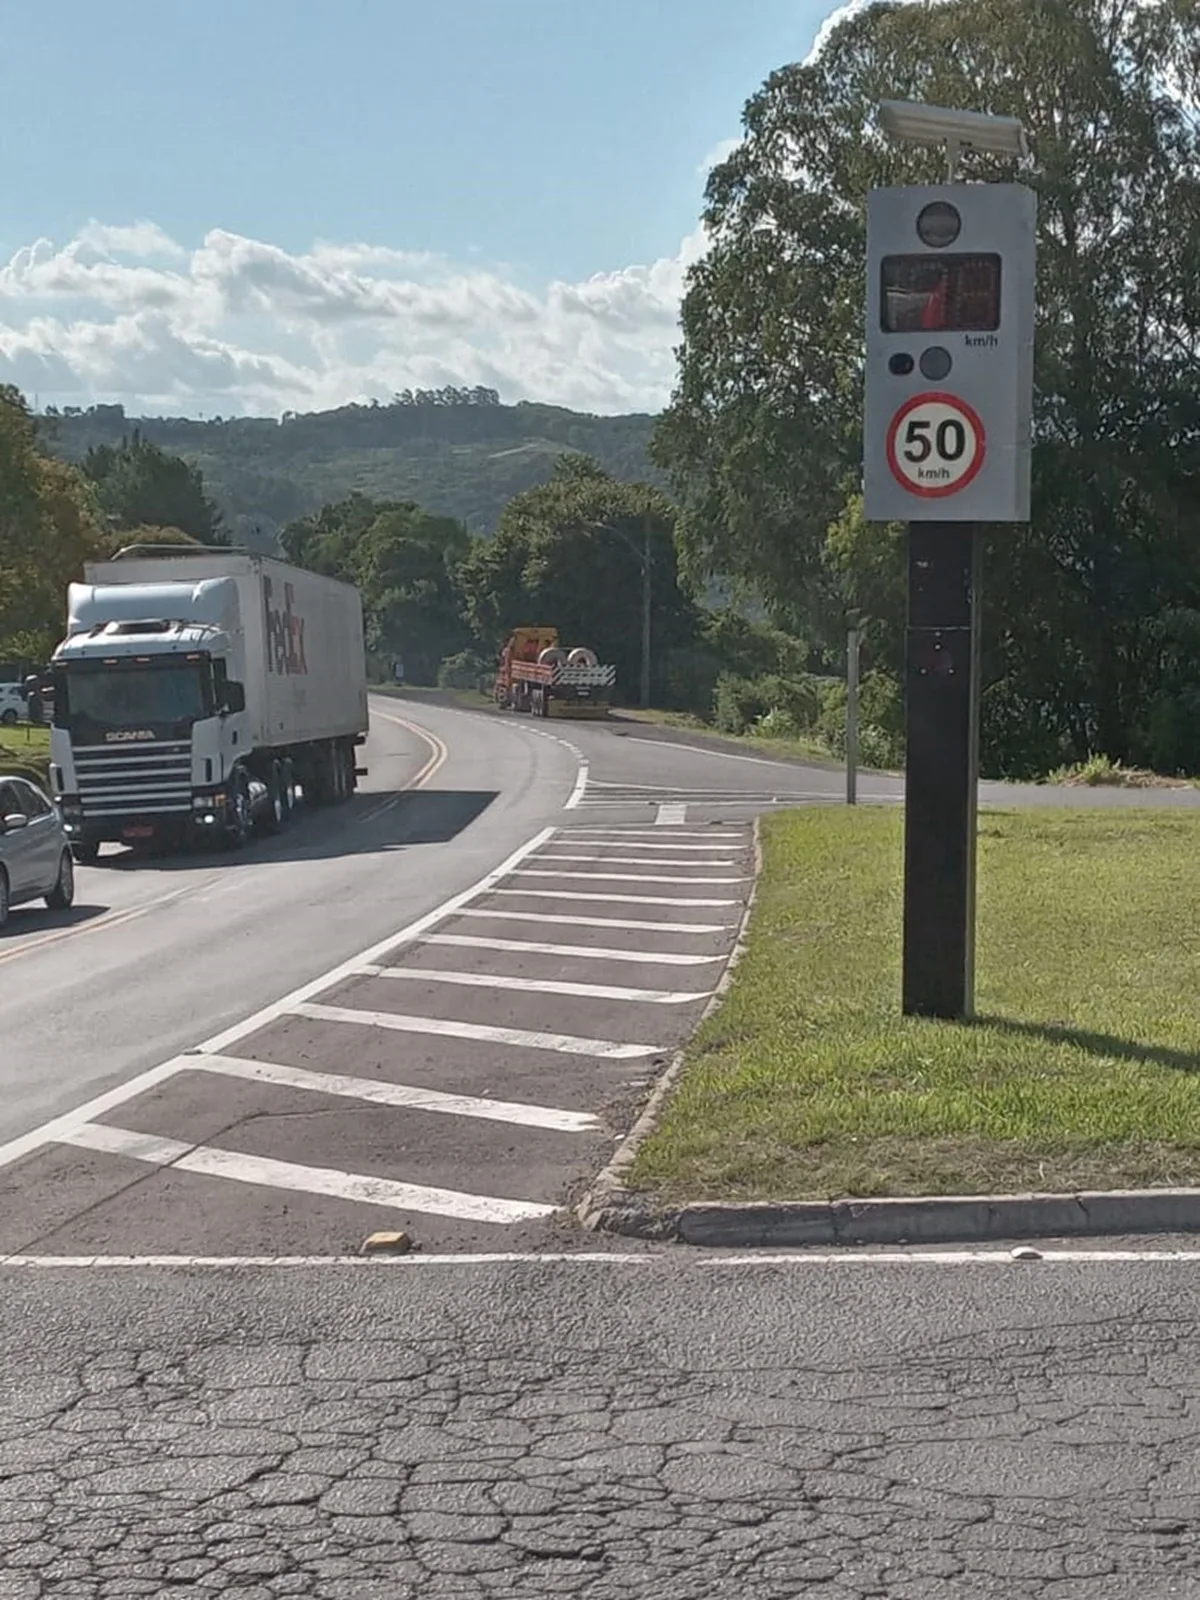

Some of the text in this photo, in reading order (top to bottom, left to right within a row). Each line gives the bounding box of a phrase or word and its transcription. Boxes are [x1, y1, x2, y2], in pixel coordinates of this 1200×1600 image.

[964, 333, 998, 347] km/h
[904, 419, 965, 463] 50
[918, 467, 950, 479] km/h
